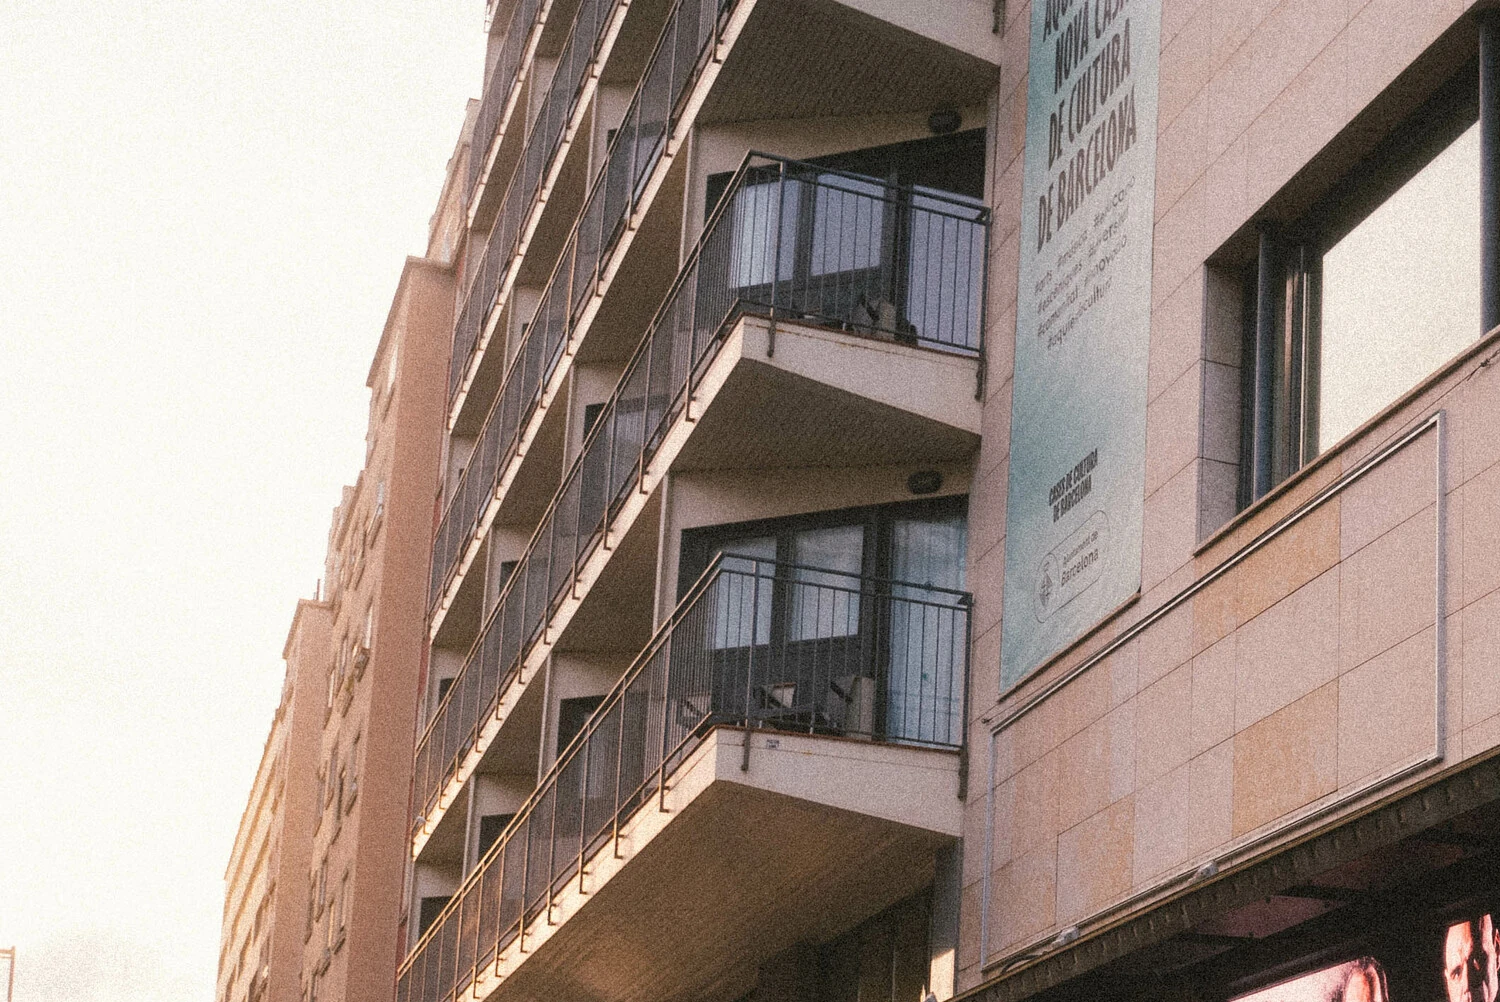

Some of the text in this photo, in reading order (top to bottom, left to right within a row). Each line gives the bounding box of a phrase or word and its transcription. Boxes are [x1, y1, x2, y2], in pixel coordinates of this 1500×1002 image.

[1048, 18, 1131, 172] DE CULTURA
[1055, 1, 1089, 94] NOVA
[1037, 85, 1137, 254] DE BARCELONA
[1061, 548, 1099, 587] Barcelona
